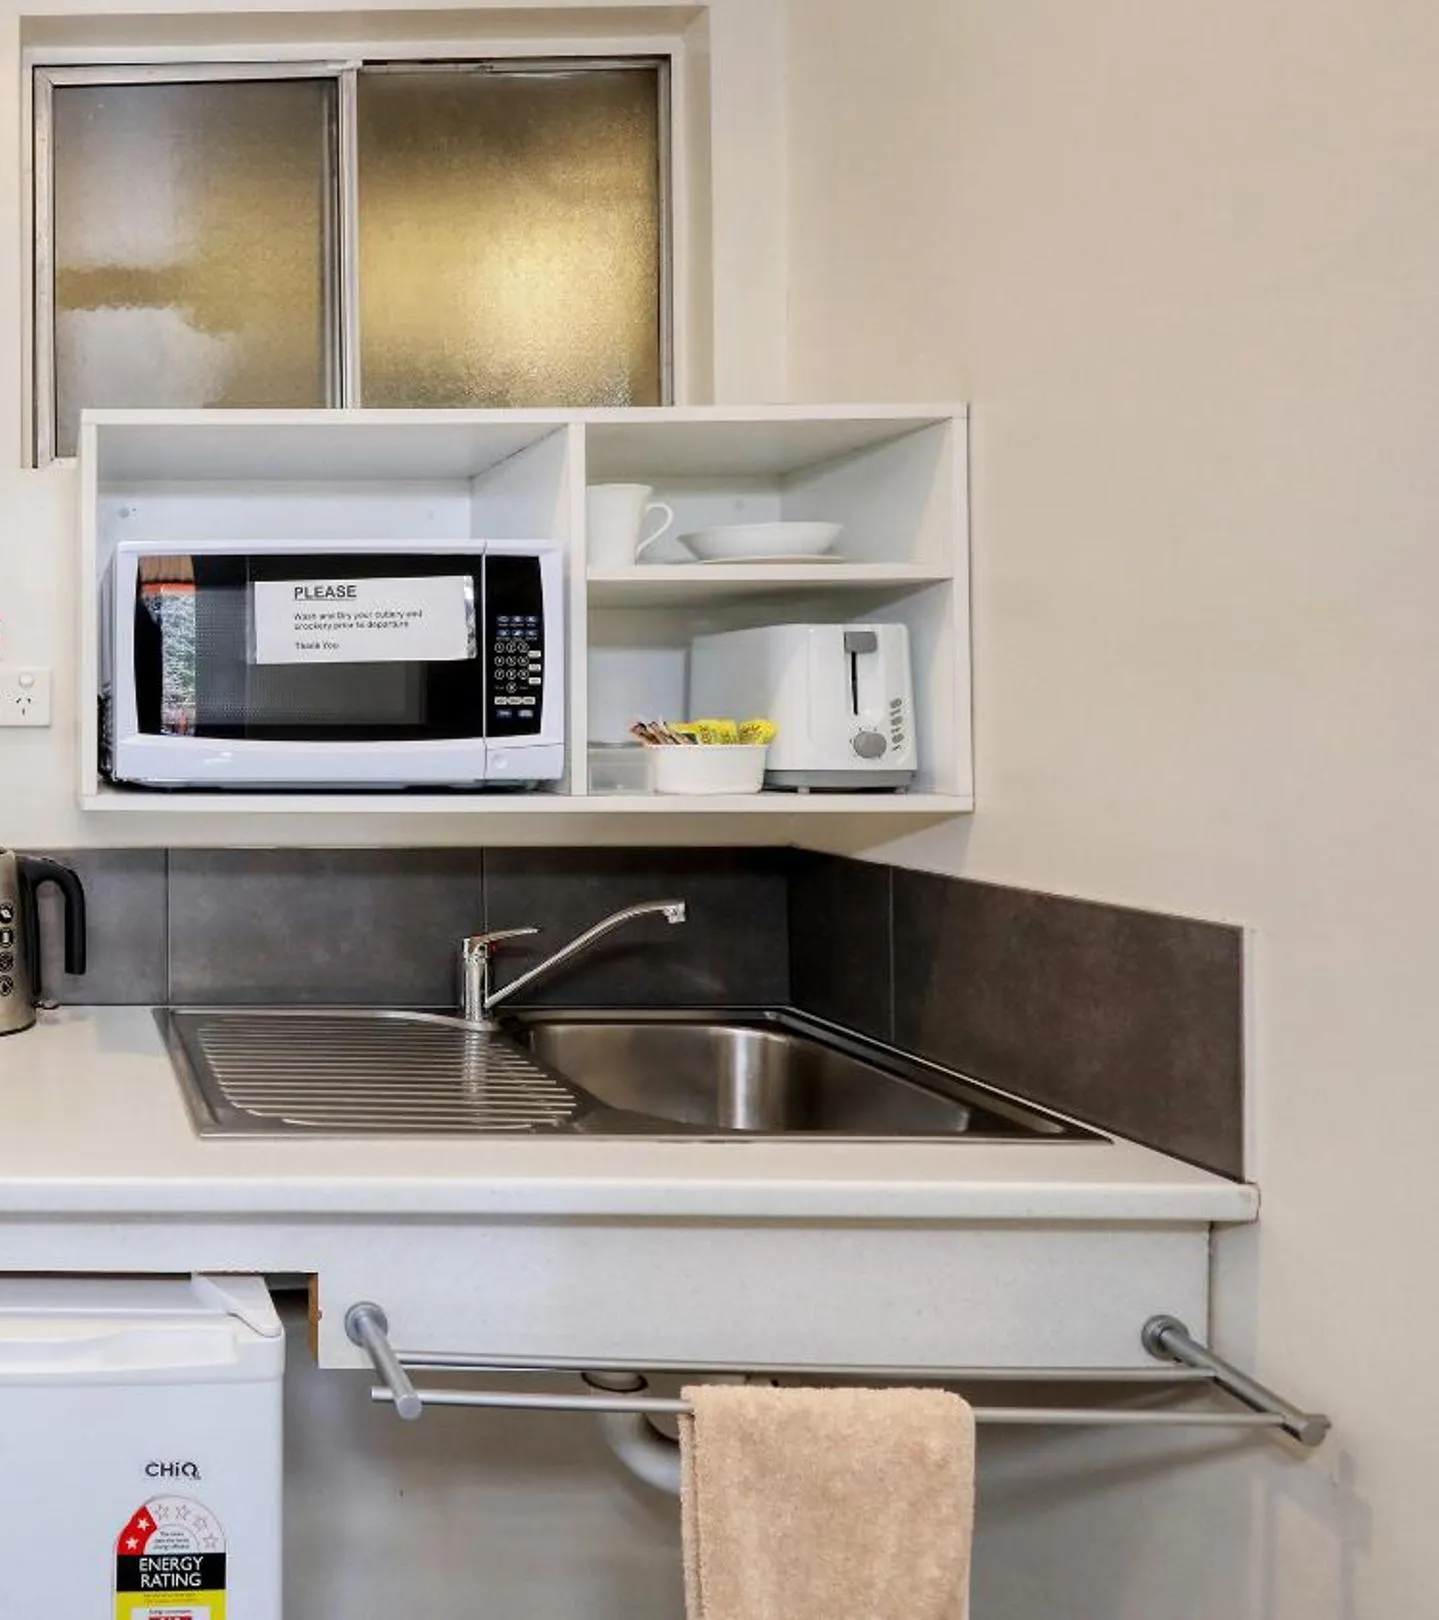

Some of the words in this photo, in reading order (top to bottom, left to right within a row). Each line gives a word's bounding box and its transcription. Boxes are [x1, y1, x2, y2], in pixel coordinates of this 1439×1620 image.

[293, 584, 357, 599] PLEASE
[138, 1556, 204, 1573] ENERGY
[140, 1572, 202, 1589] RATING
